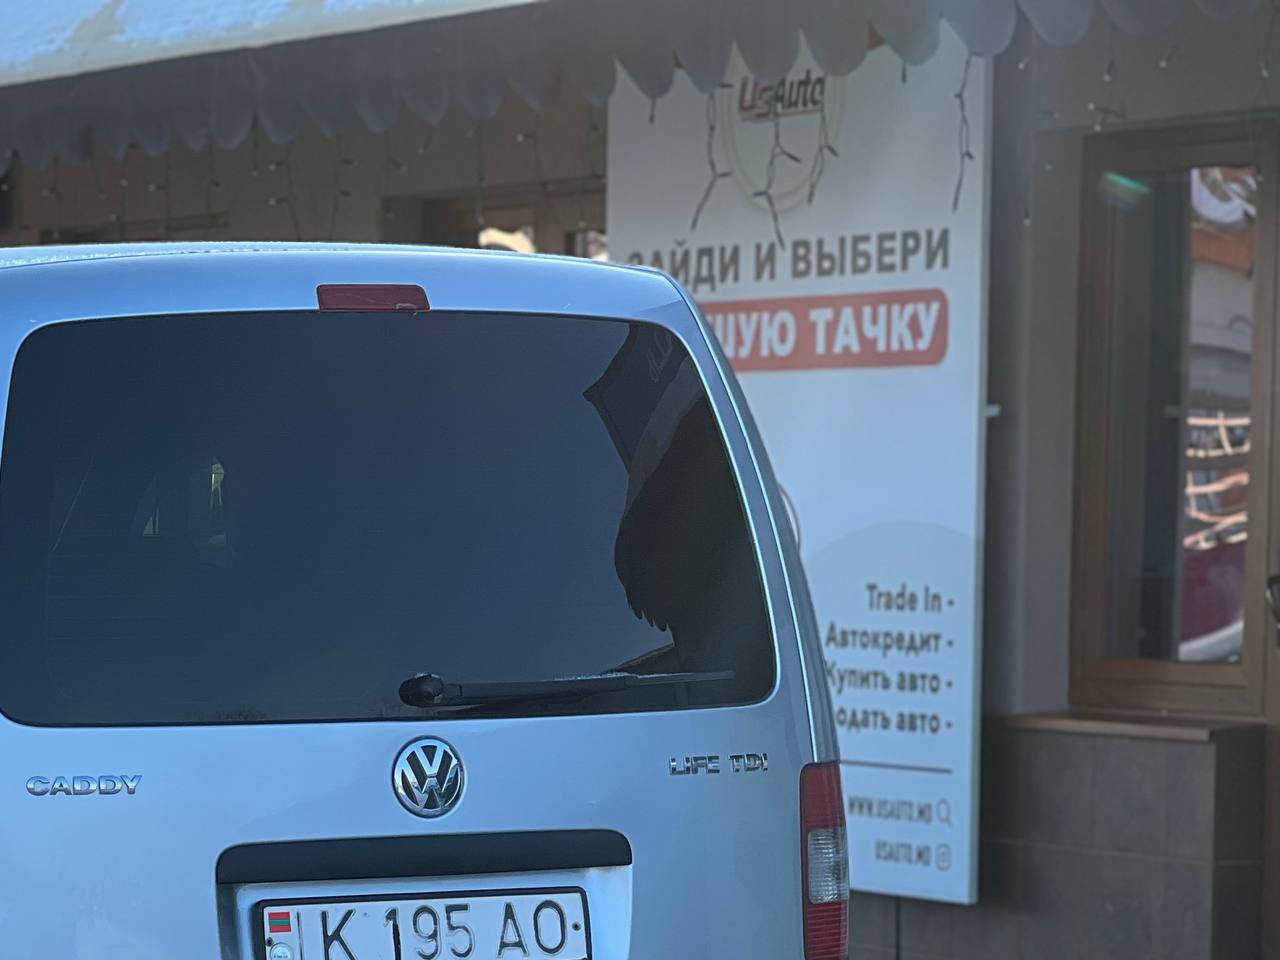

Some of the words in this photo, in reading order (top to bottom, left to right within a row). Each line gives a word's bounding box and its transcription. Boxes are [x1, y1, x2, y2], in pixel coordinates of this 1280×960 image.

[754, 242, 775, 281] И
[791, 227, 950, 279] ВЫБЕРИ
[705, 309, 797, 359] ШУЮ
[809, 301, 940, 355] ТАЧКУ
[866, 583, 918, 611] Trade
[924, 585, 942, 612] In
[825, 621, 941, 658] Автокредит
[897, 671, 940, 693] авто
[835, 707, 891, 733] одать
[896, 711, 940, 734] авто
[729, 753, 768, 772] TDI
[26, 774, 143, 797] CADDY
